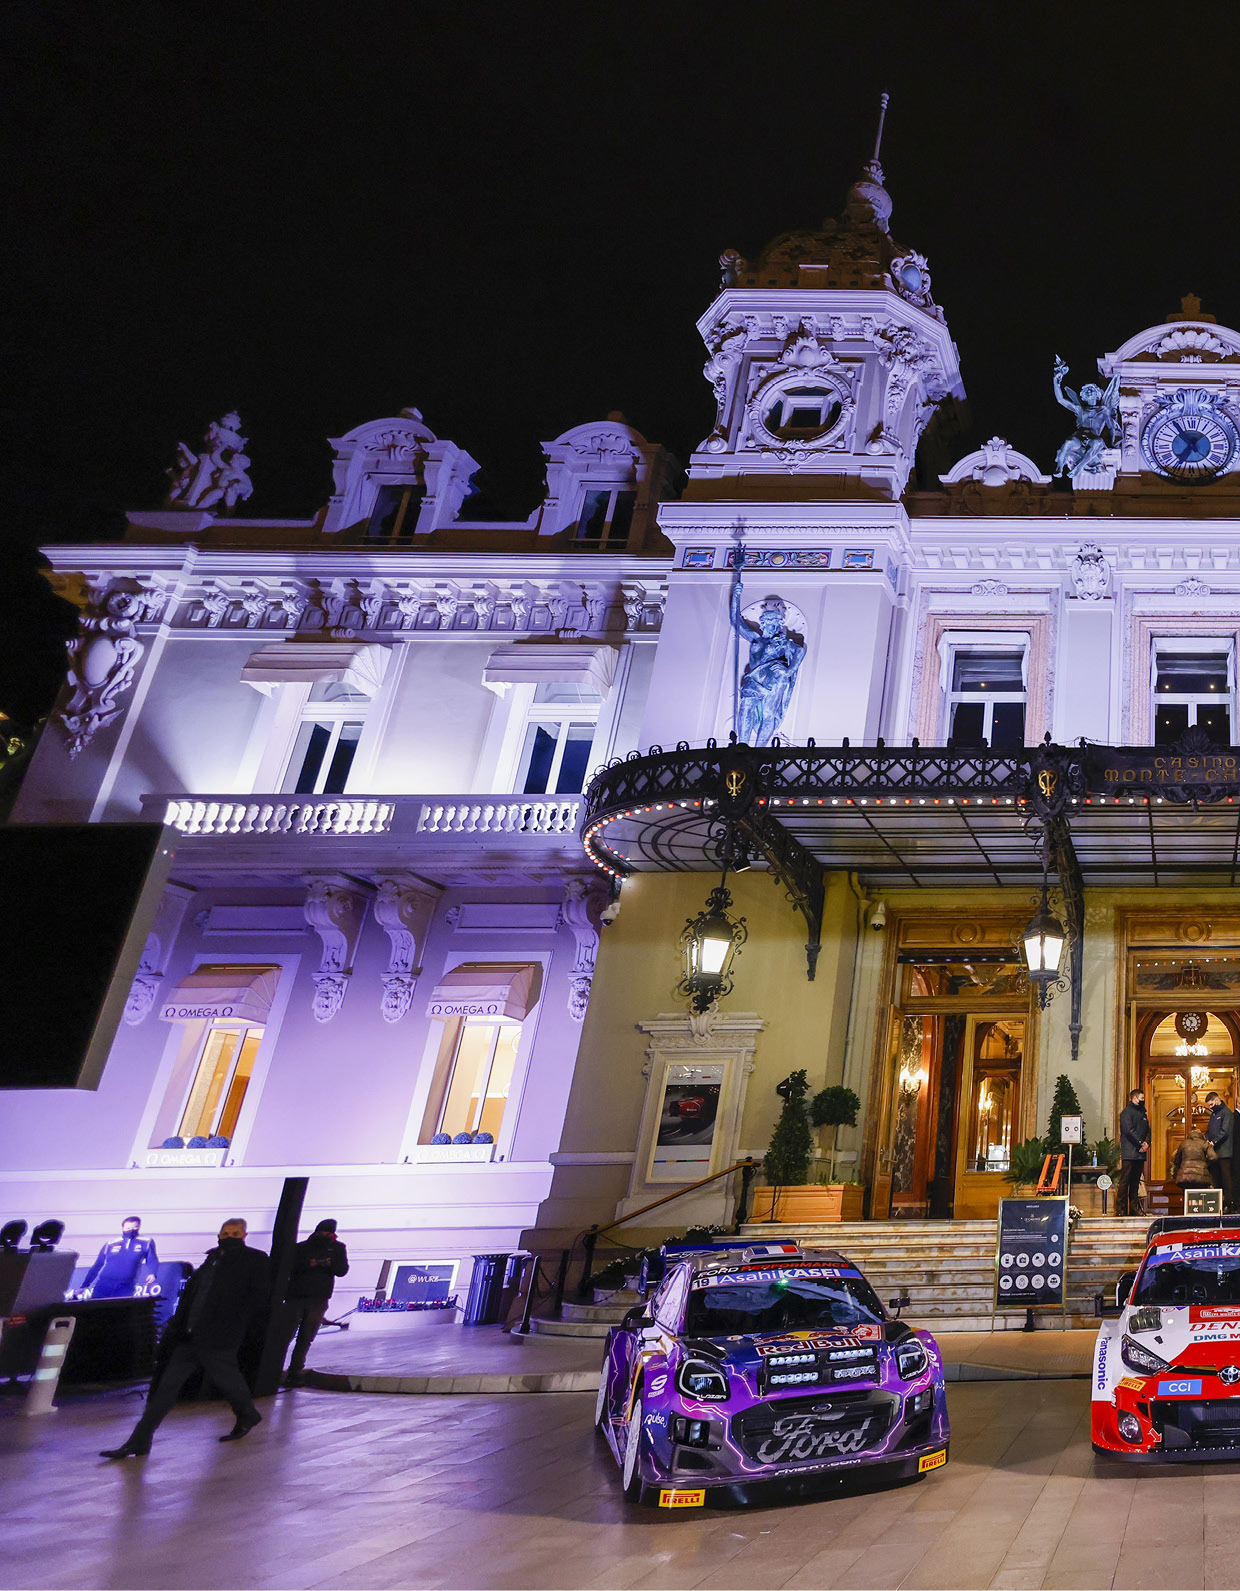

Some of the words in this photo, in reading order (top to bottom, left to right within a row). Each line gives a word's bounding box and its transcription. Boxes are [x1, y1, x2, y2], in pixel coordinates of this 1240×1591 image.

[1154, 757, 1237, 769] CASINO
[178, 1008, 218, 1017] OMEGA
[444, 1006, 484, 1014] OMEGA
[698, 1266, 739, 1278] FORD
[741, 1262, 849, 1272] PERFORMANCE
[694, 1278, 710, 1288] 19
[1194, 1334, 1228, 1342] DMG
[756, 1340, 812, 1356] Red
[810, 1338, 862, 1350] Bull
[1098, 1336, 1112, 1390] Panasonic
[756, 1411, 874, 1464] Ford
[922, 1453, 945, 1469] PIRELLI
[662, 1493, 701, 1504] PIRELLI
